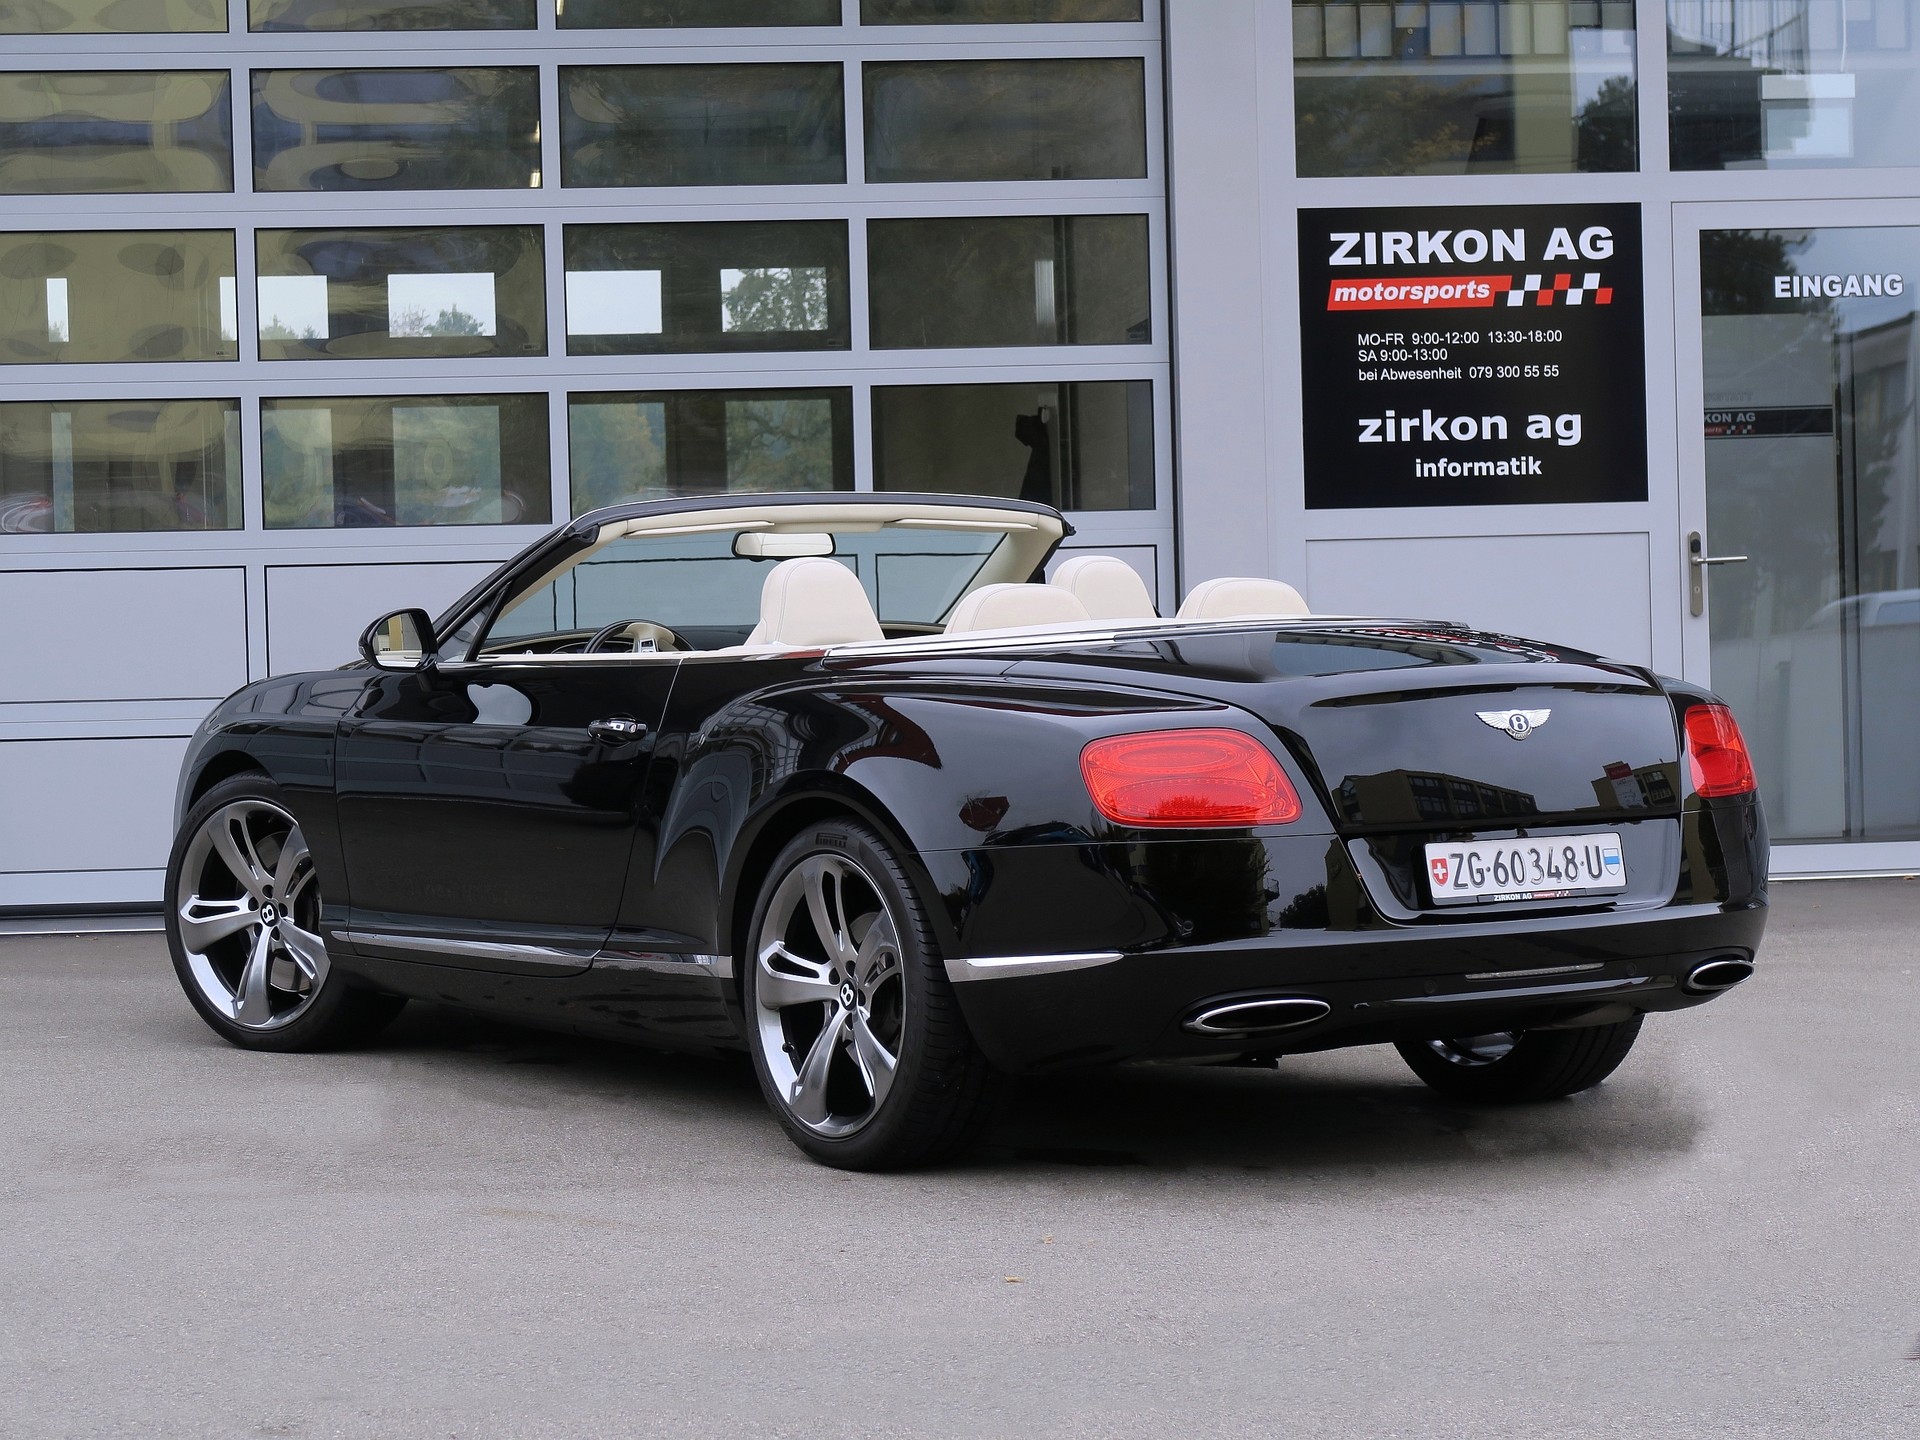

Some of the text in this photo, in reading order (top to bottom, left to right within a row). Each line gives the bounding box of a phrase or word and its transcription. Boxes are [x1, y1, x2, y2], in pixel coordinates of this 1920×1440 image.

[1328, 226, 1614, 266] ZIRKON AG
[1334, 279, 1491, 304] motorsports
[1773, 273, 1904, 298] EINGANG
[1357, 329, 1563, 347] MO-FR 9:00-12:00 13:30-18:00
[1358, 348, 1448, 362] SA 9:00-13:00
[1358, 364, 1560, 381] bei Abwesenheit 079 300 55 55
[1736, 412, 1756, 422] AG
[1358, 408, 1582, 447] zirkon ag
[1415, 456, 1543, 478] informatik
[1511, 714, 1527, 731] B
[1494, 892, 1521, 902] ZIRKON
[1522, 892, 1533, 900] AG
[261, 907, 275, 924] B
[840, 983, 854, 1006] B
